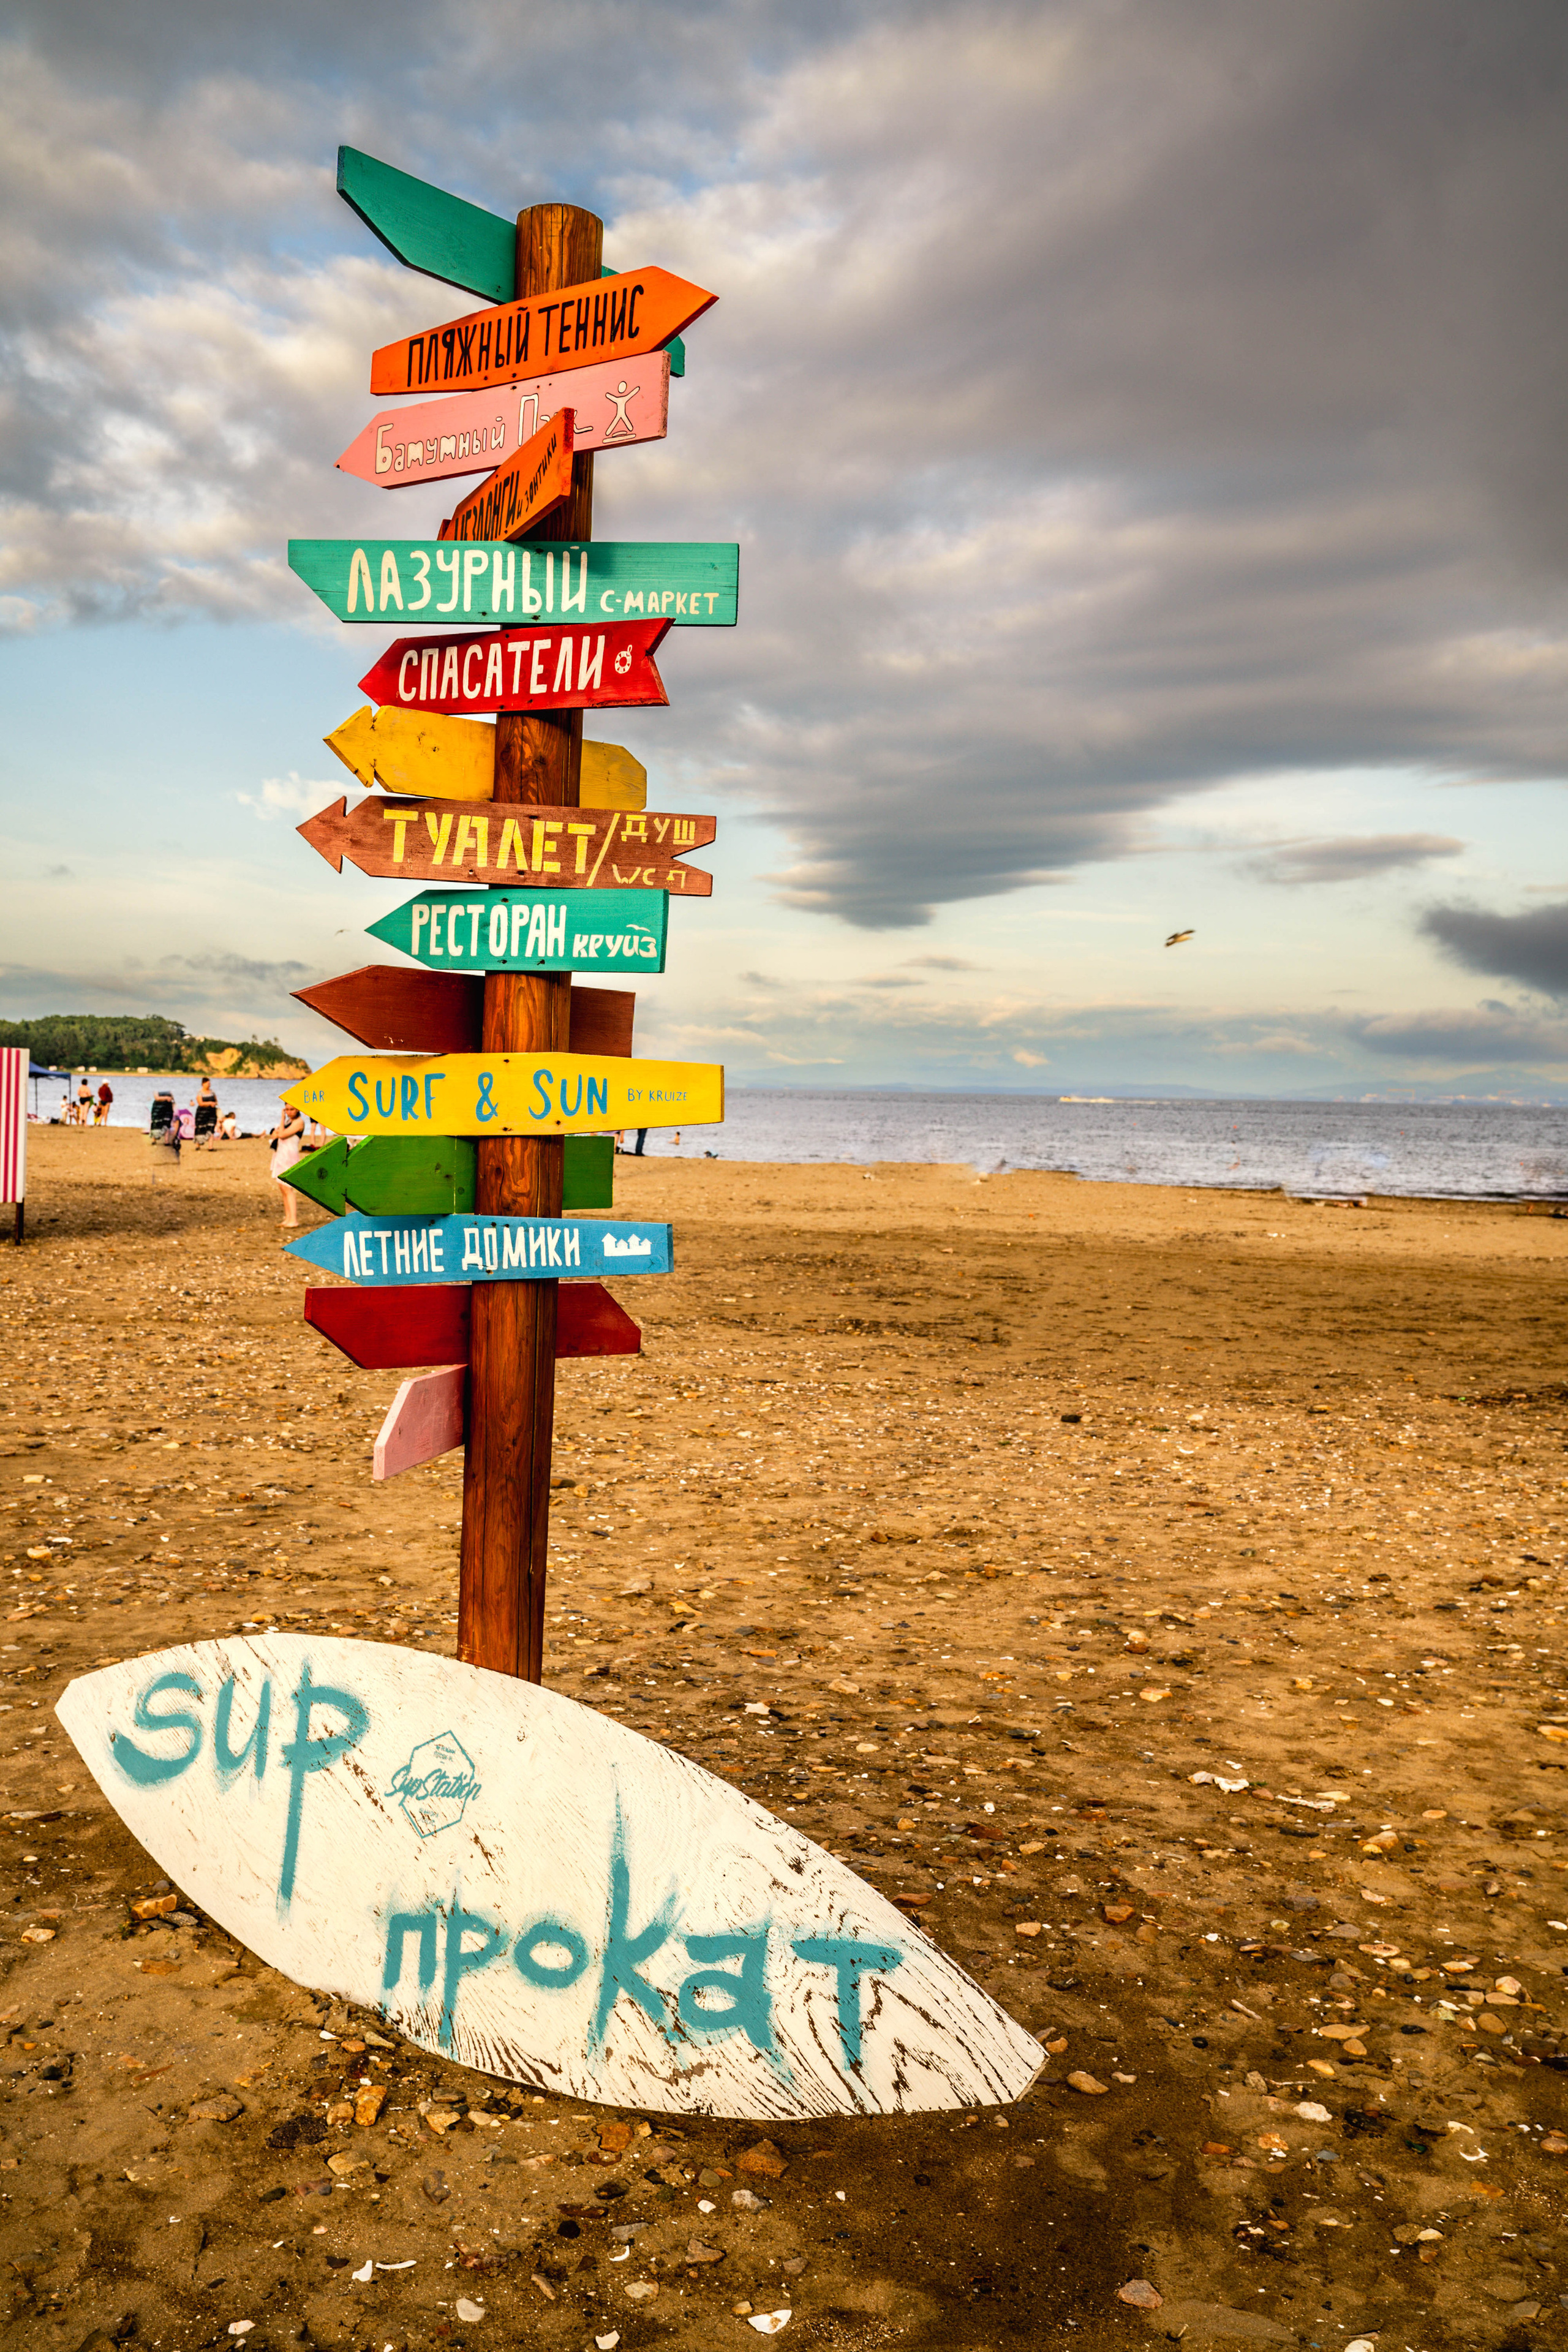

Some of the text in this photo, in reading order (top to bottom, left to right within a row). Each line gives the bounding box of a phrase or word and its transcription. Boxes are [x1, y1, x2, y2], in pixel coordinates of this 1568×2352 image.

[407, 284, 644, 387] ПЛЯЖНЫЙ ТЕННИС
[347, 545, 720, 615] ЛАЗУРНЫЙ С-МАРКЕТ
[398, 635, 605, 702] СПАСАТЕЛИ
[612, 864, 656, 886] WC
[412, 904, 567, 957] РЕСТОРАН
[304, 1068, 687, 1122] BAR SURF & SUN BY KRUIZE
[344, 1227, 581, 1278] ЛЕТНИЕ ДОМИКИ
